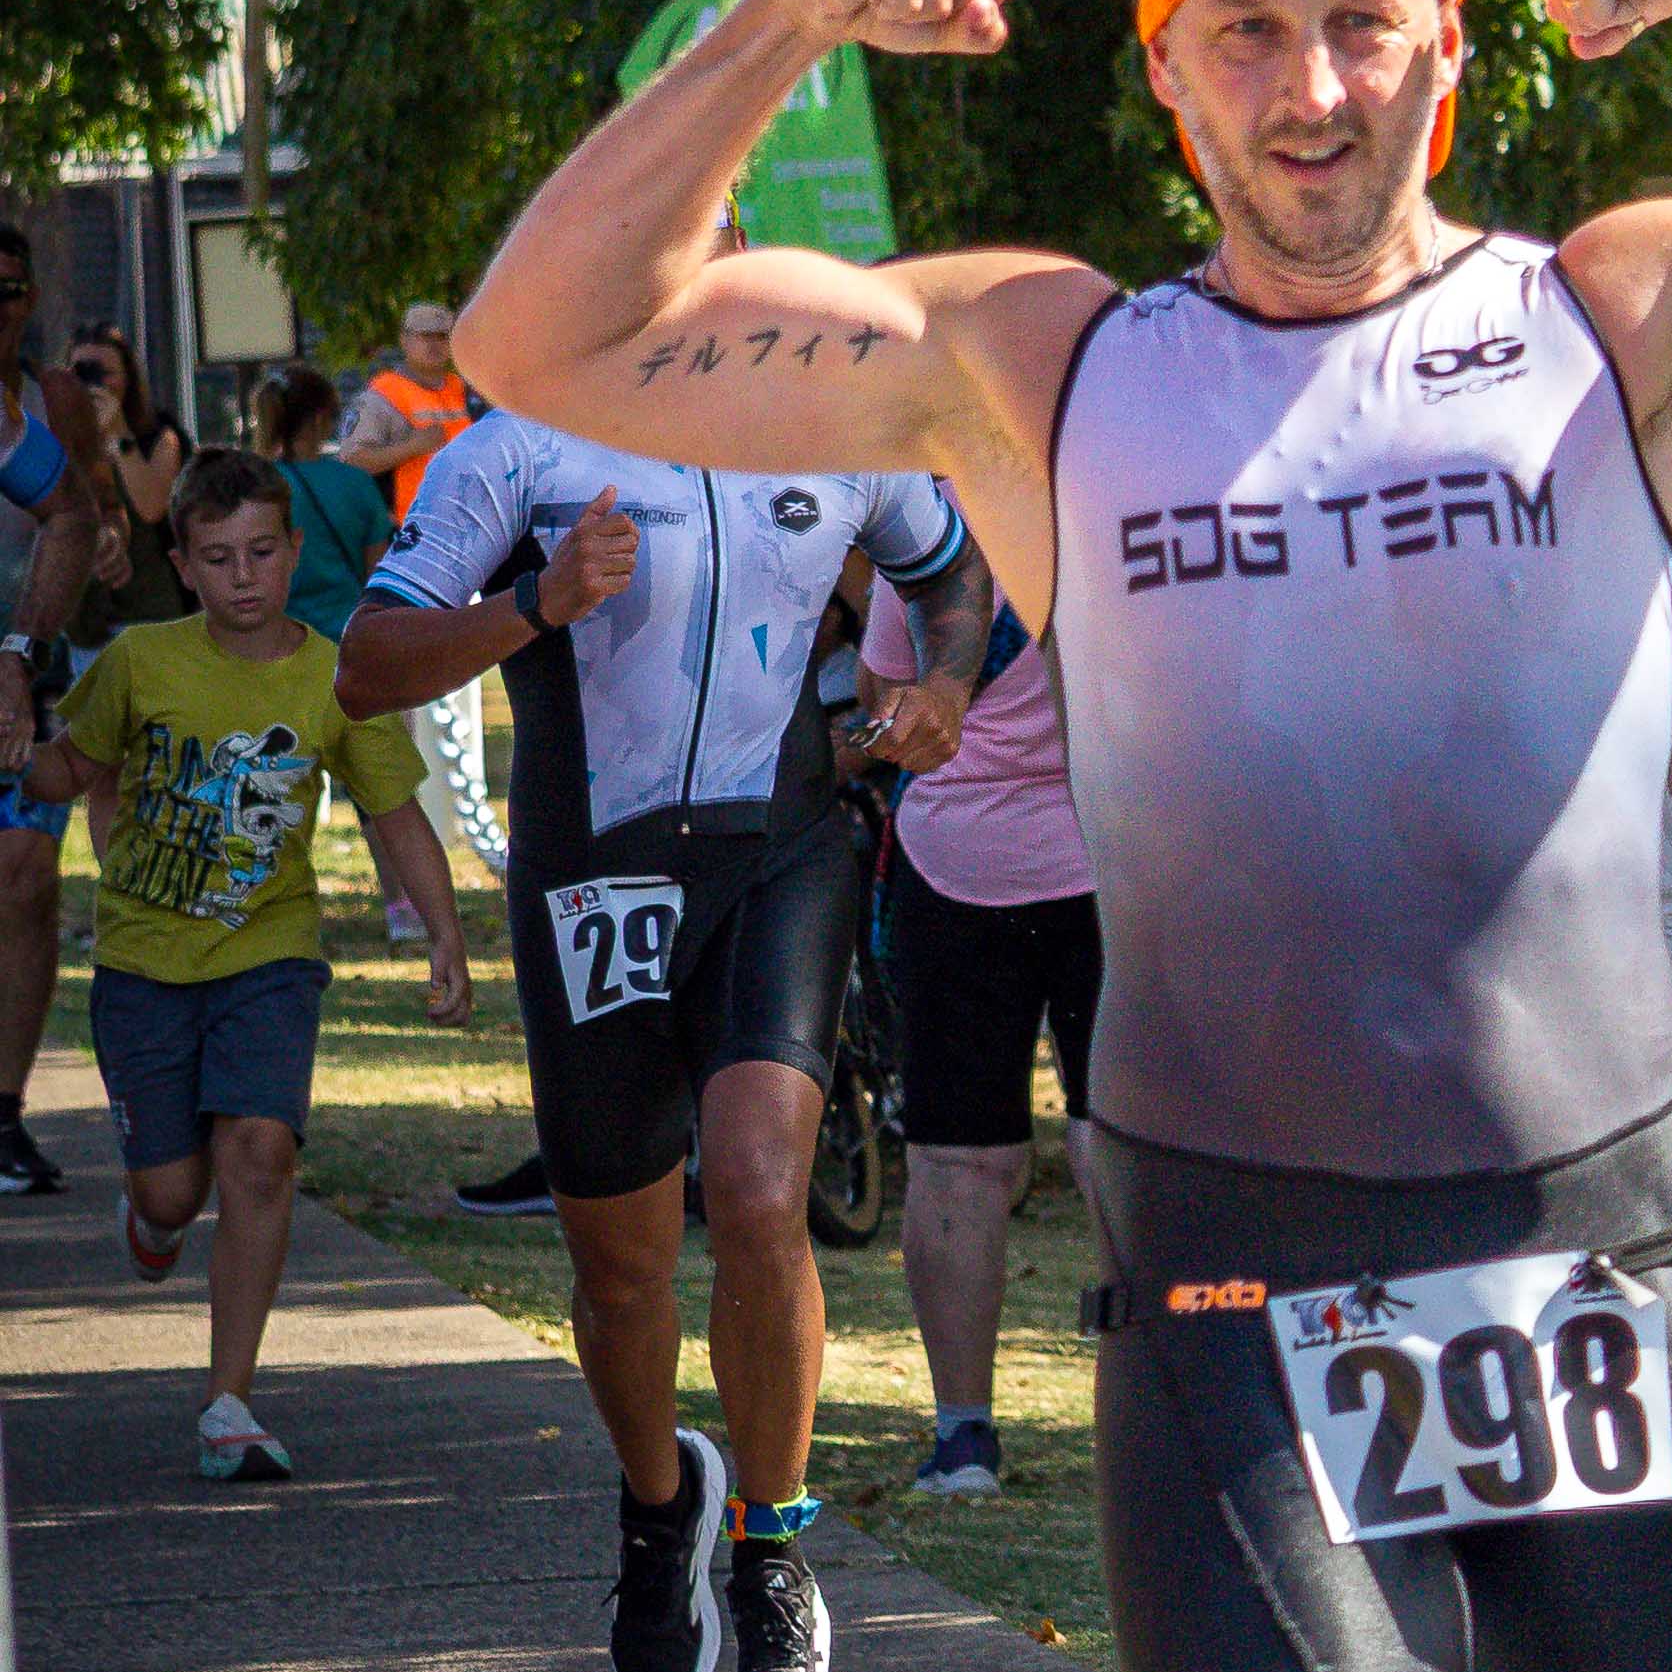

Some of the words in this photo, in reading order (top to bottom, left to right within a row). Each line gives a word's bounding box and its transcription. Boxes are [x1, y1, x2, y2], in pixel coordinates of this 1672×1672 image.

[1119, 503, 1289, 594] SDG
[1317, 470, 1558, 569] TEAM
[1325, 1311, 1651, 1527] 298
